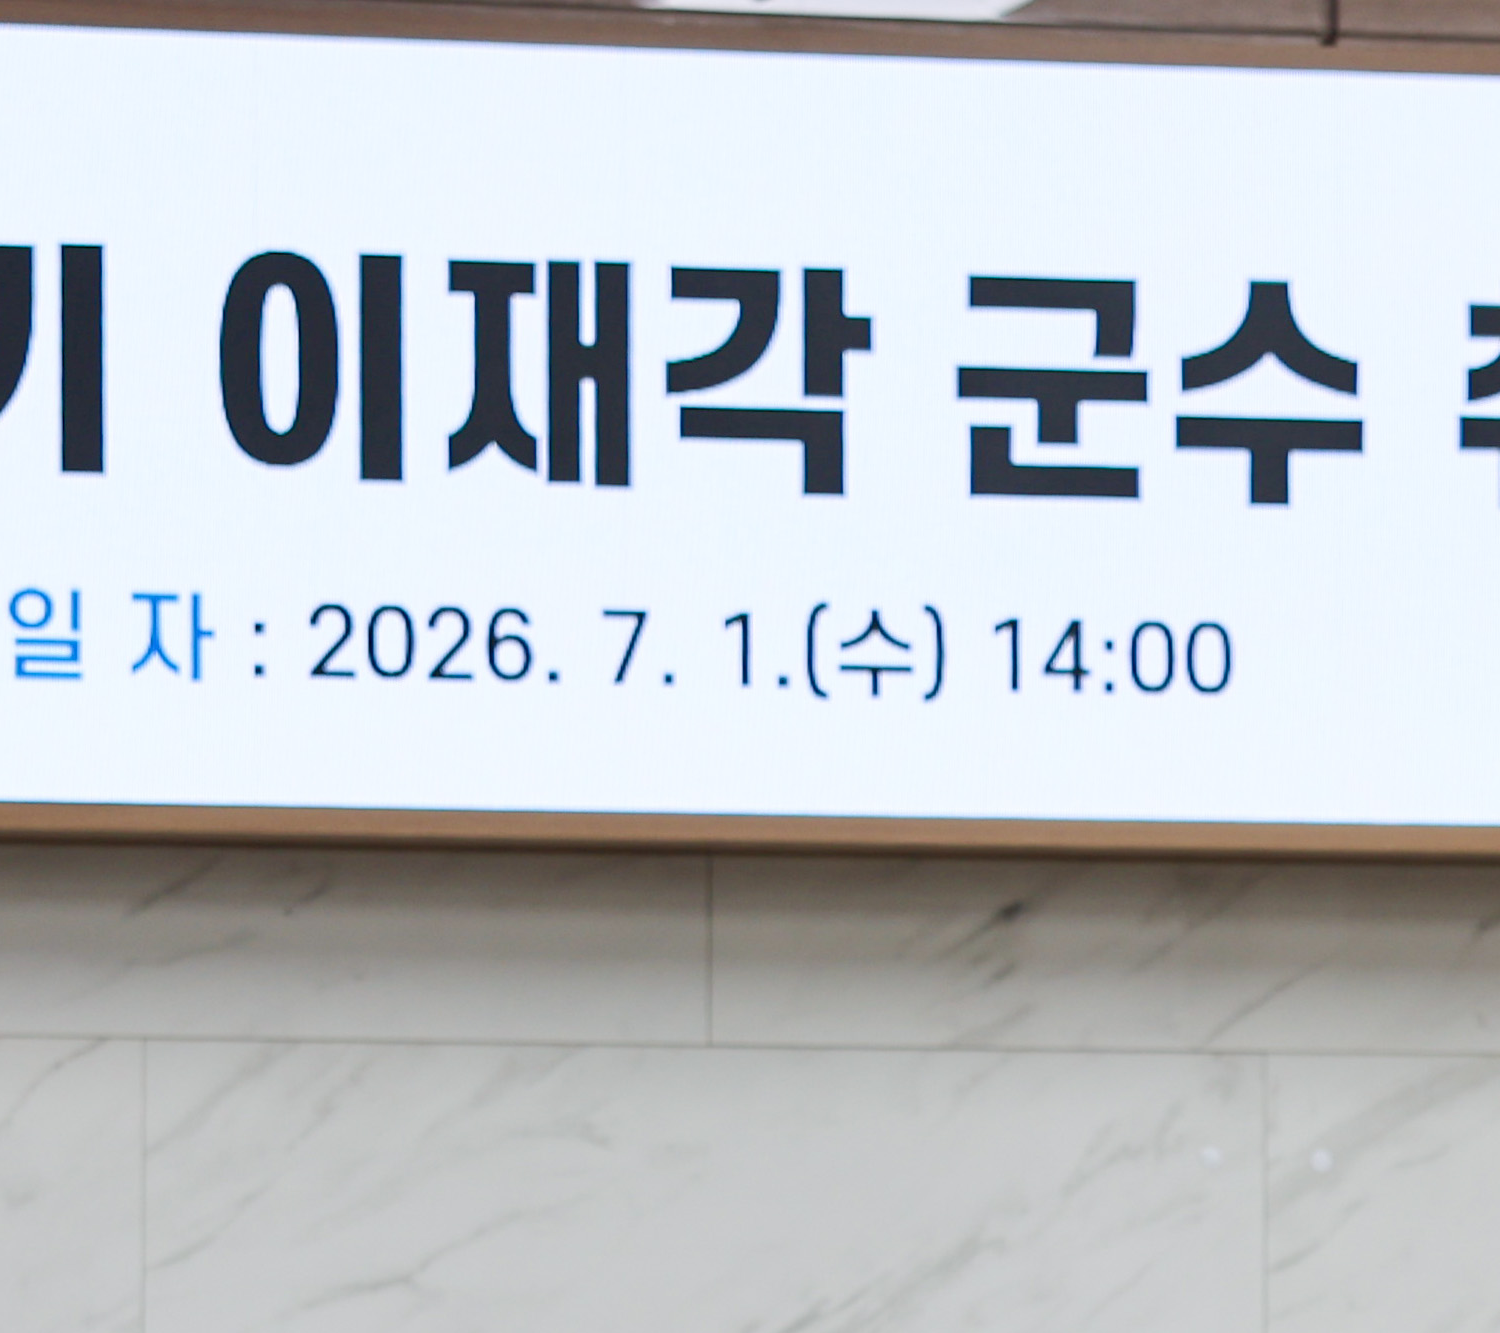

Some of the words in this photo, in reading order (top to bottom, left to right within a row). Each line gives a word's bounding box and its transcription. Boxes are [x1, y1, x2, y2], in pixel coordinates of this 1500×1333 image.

[218, 249, 873, 497] 이재각
[956, 274, 1365, 506] 군수
[309, 603, 560, 683] 2026.
[602, 609, 674, 685] 7.
[724, 602, 945, 702] 1.(수)
[994, 617, 1232, 694] 14:00
